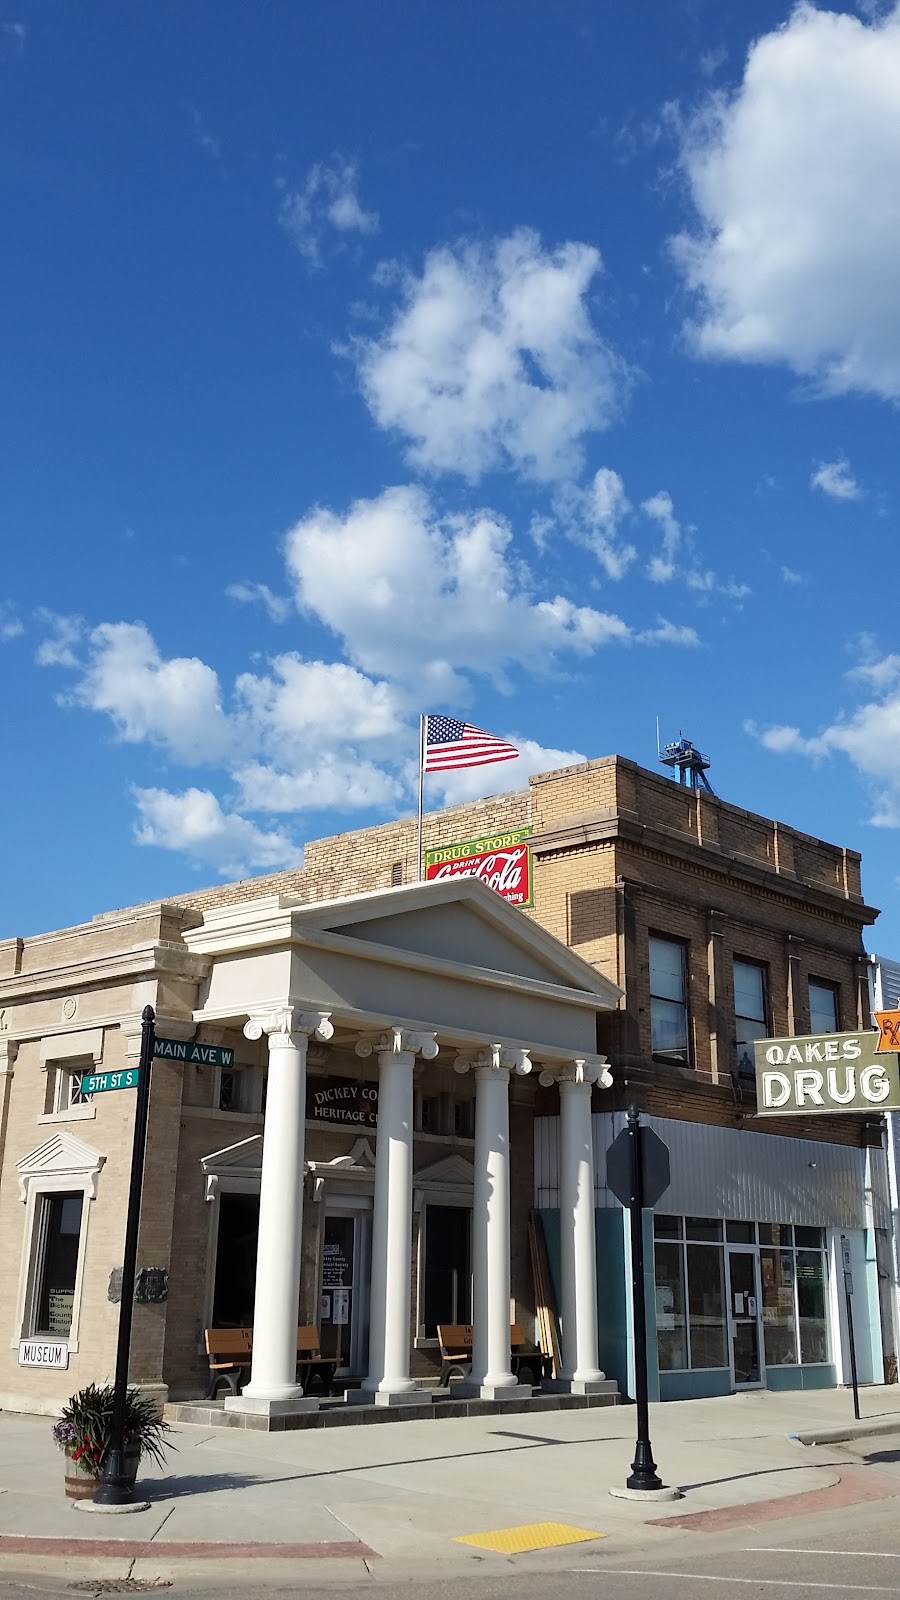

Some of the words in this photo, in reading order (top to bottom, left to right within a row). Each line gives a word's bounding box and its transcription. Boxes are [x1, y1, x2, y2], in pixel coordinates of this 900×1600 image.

[433, 846, 470, 863] DRUG
[475, 834, 521, 853] STORE
[452, 857, 481, 870] DRINK
[153, 1041, 187, 1059] MAIN
[191, 1047, 216, 1063] AVE
[221, 1051, 232, 1065] W
[765, 1039, 862, 1066] OAKES
[88, 1076, 107, 1091] 5TH
[110, 1073, 123, 1088] ST
[125, 1072, 133, 1085] S
[762, 1064, 890, 1108] DRUG
[314, 1087, 358, 1104] DICKEY
[314, 1106, 366, 1122] HERITAGE
[23, 1345, 62, 1363] MUSEUM
